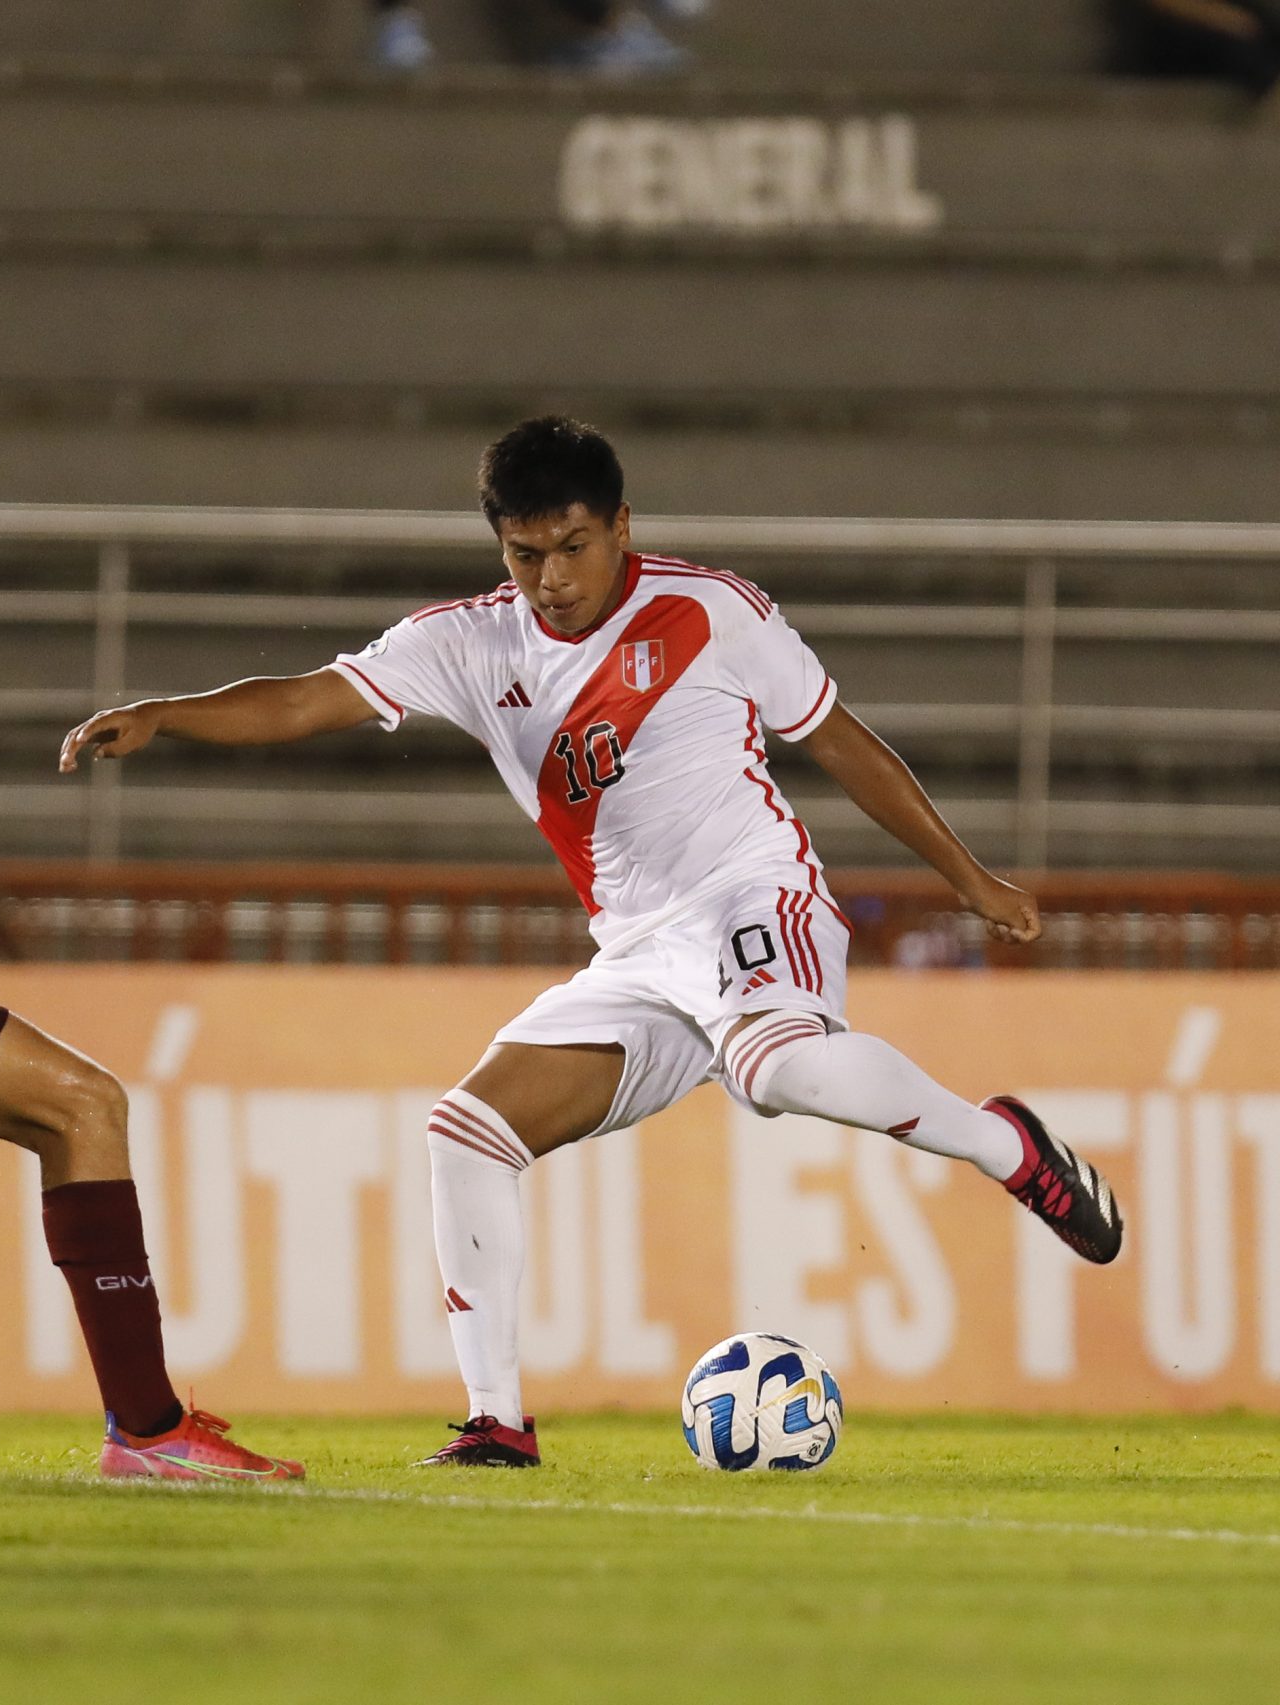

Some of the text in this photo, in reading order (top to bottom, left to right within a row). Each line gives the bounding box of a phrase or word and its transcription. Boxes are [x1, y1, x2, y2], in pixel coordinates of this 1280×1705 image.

[559, 114, 943, 231] GENERAL
[553, 720, 626, 805] 10
[95, 1275, 154, 1290] GIV
